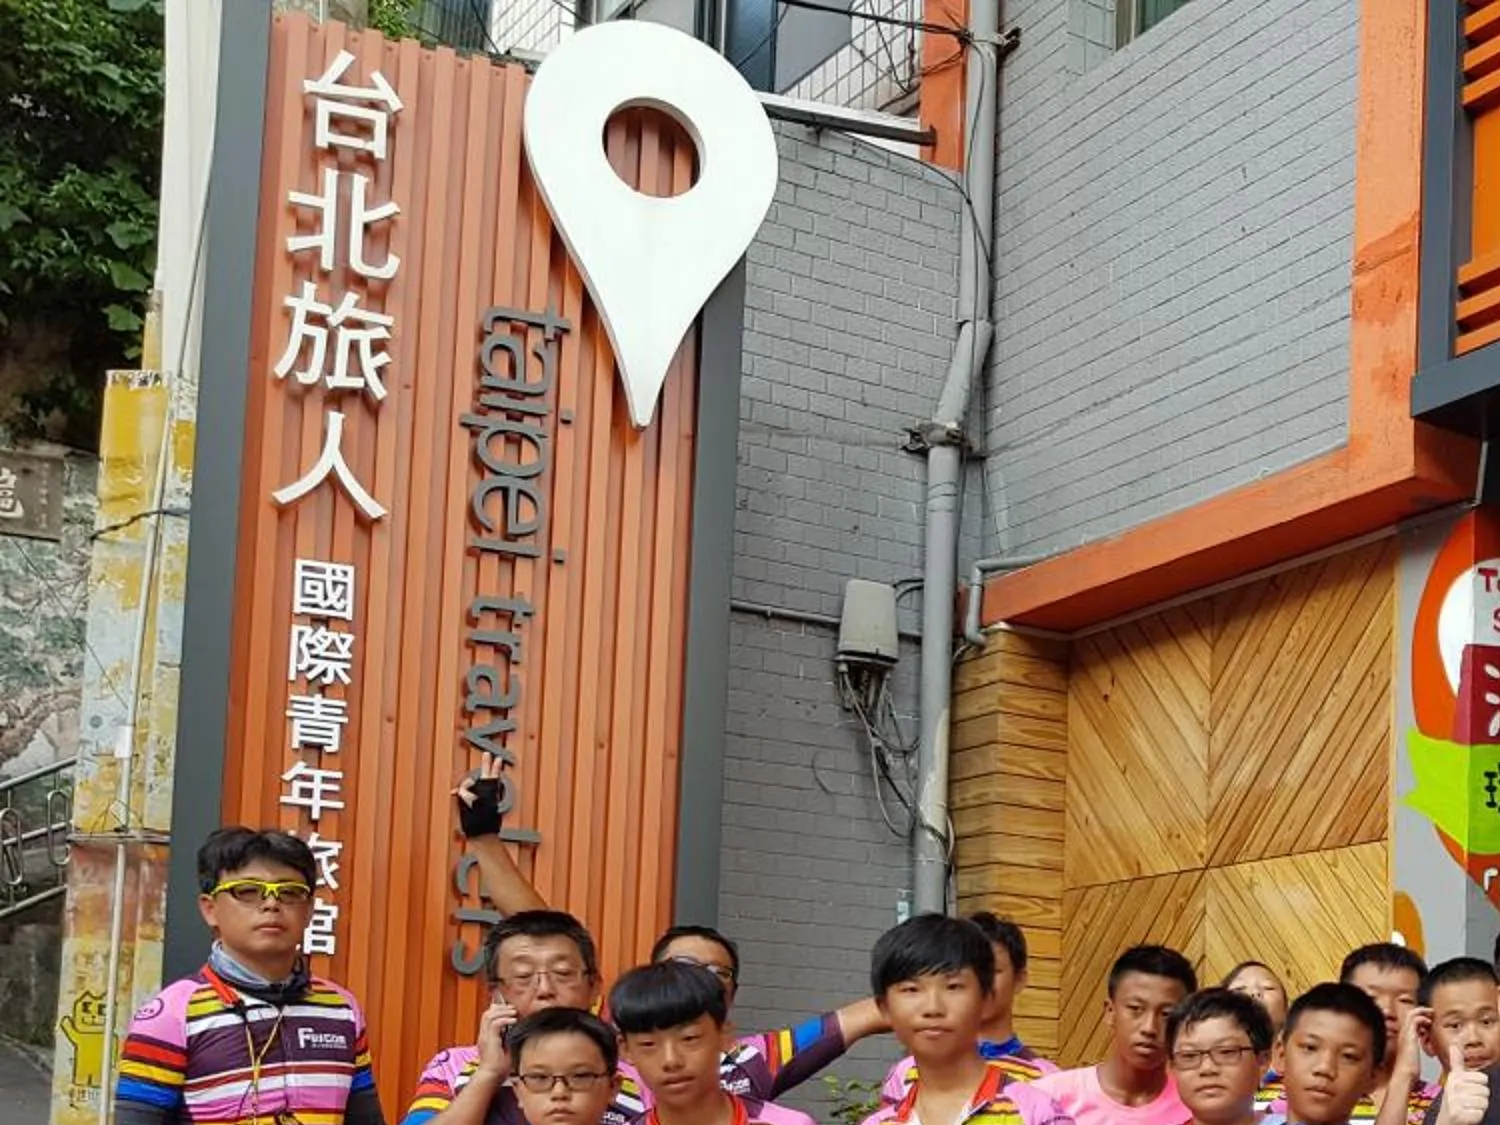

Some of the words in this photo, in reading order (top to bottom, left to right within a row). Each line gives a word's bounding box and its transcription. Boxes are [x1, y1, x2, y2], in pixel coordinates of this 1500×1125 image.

[272, 49, 403, 524] 台北旅人
[459, 304, 571, 565] taipei
